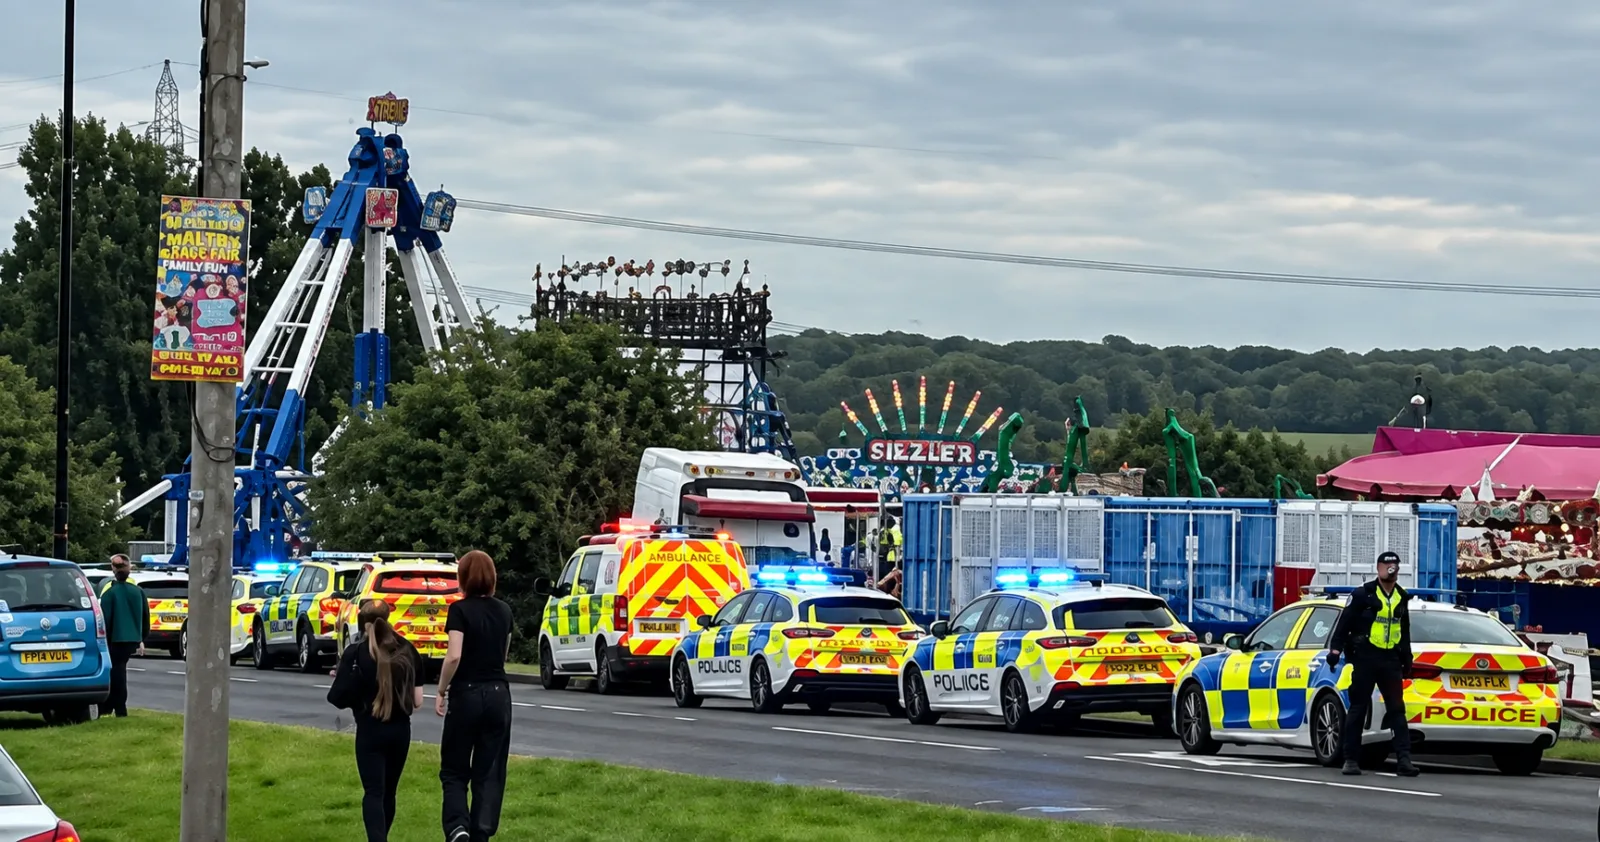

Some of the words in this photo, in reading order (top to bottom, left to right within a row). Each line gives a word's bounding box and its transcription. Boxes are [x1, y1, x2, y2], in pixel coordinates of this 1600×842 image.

[210, 248, 240, 261] FAIR
[163, 259, 203, 272] FAMILY
[204, 262, 228, 274] FUN
[649, 553, 722, 563] AMBULANCE
[1484, 676, 1507, 688] FLK
[1424, 706, 1536, 722] POLICE
